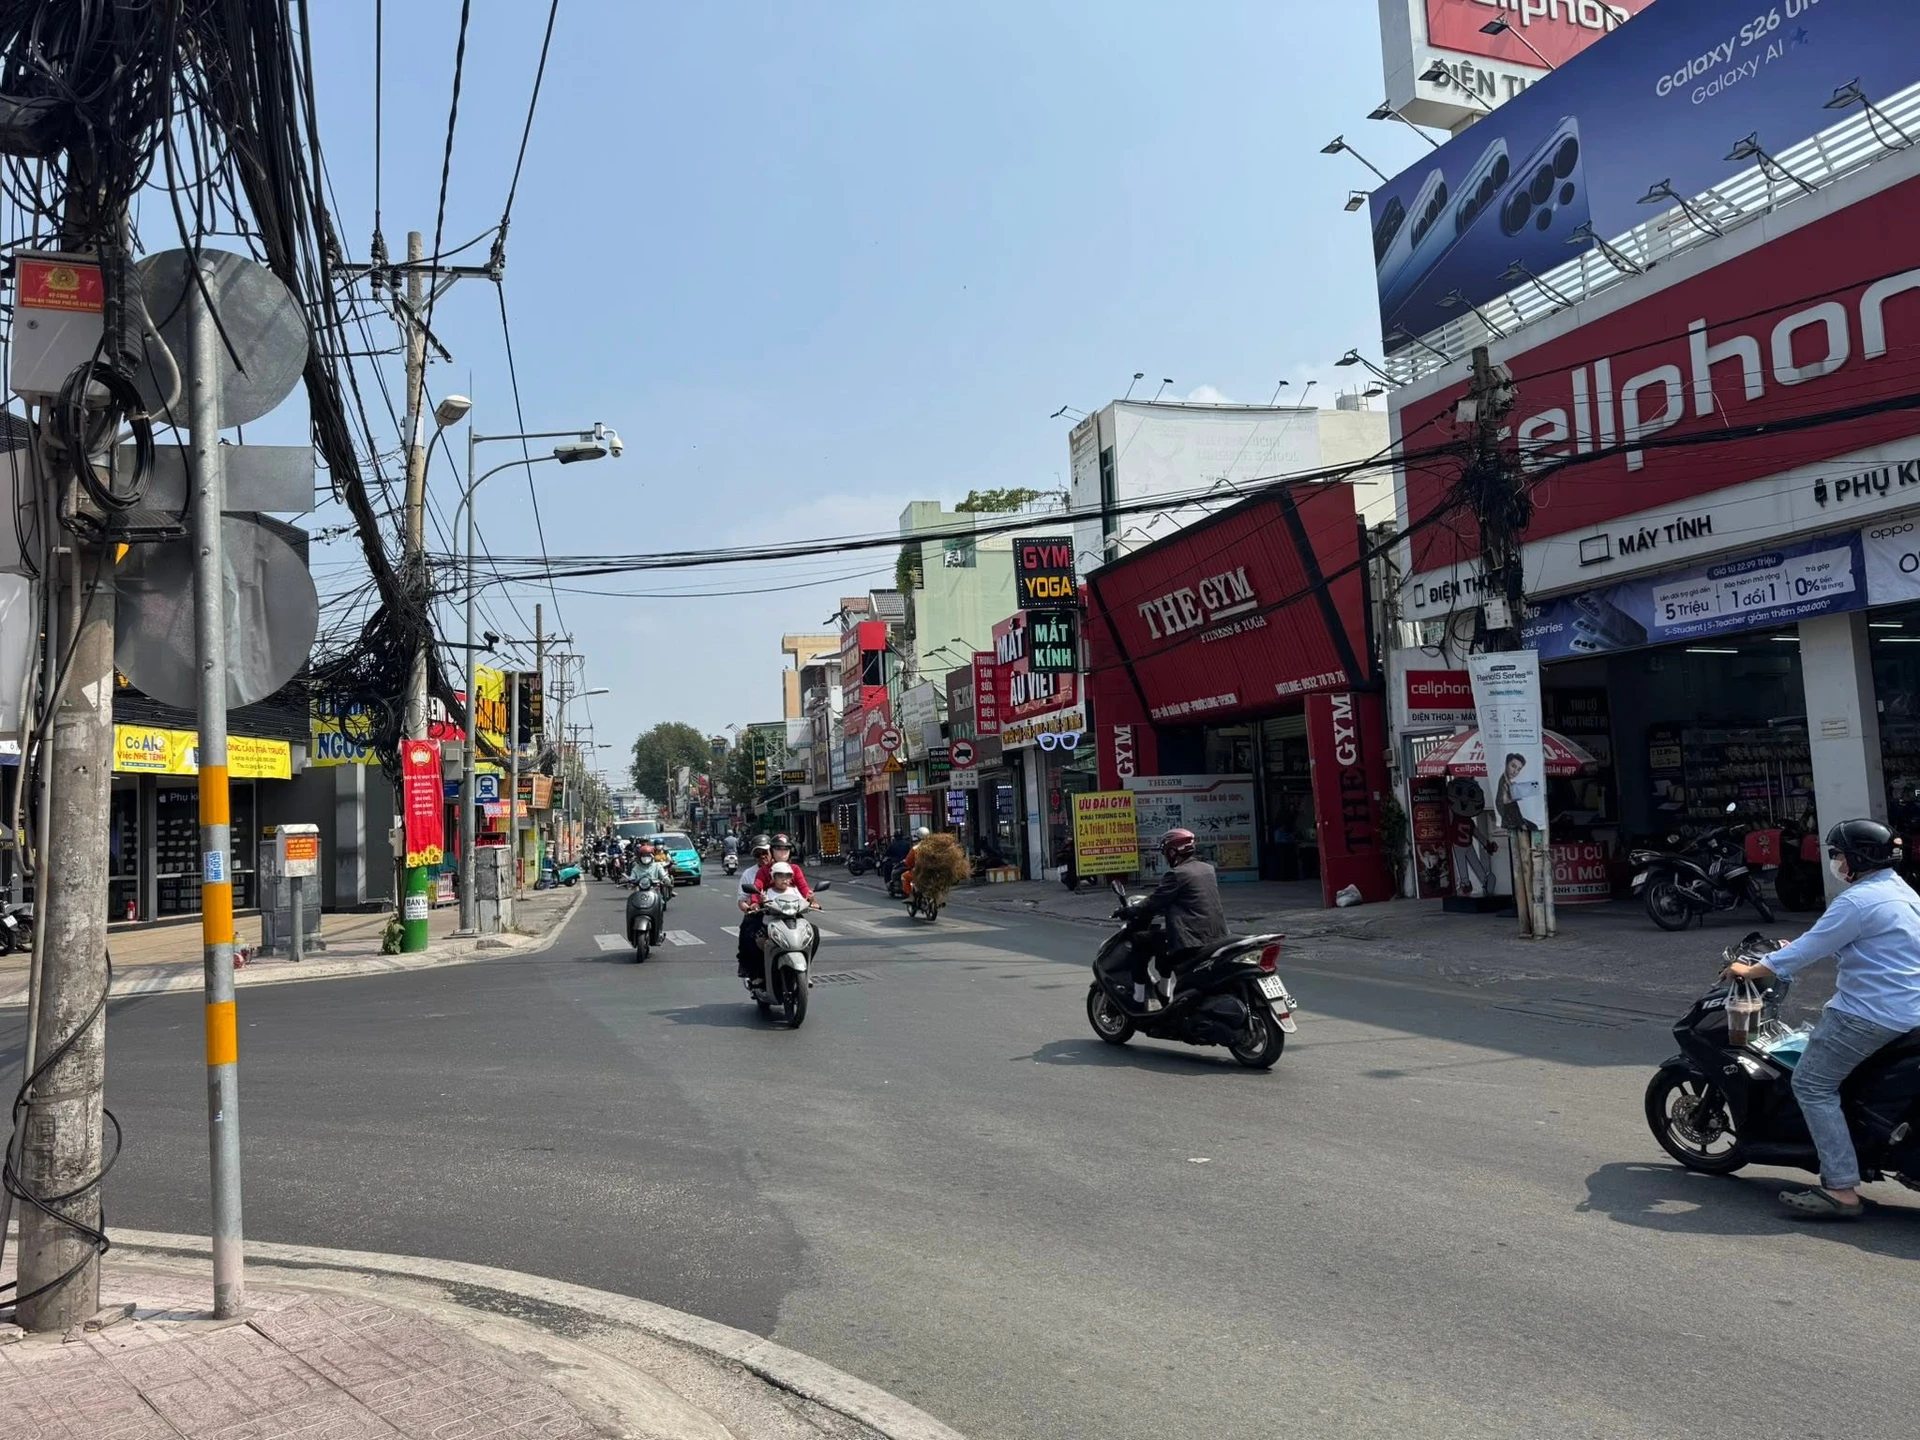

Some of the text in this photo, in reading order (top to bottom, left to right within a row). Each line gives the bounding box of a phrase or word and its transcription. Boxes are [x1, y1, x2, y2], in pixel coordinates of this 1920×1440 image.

[1656, 7, 1780, 97] Galaxy S26
[1691, 39, 1783, 104] Galaxy AI
[1835, 467, 1890, 502] PHỤ
[1619, 514, 1713, 555] MÁY TÍNH
[1870, 522, 1914, 541] oppo
[1023, 545, 1070, 569] GYM
[1025, 576, 1073, 598] YOGA
[1429, 579, 1461, 604] ĐIỆN
[1731, 583, 1776, 608] 1 đổi 1
[1795, 577, 1820, 596] 0%
[1137, 566, 1255, 640] THE GYM
[1665, 599, 1710, 621] 5 Triệu
[1034, 616, 1069, 642] MẮT
[1242, 615, 1268, 631] YOGA
[1535, 622, 1563, 636] Series
[1034, 644, 1072, 666] KÍNH
[1010, 671, 1026, 707] ÂU
[1412, 711, 1430, 722] ĐIỆN
[1431, 712, 1454, 723] THOẠI
[1330, 693, 1358, 766] GYM
[125, 736, 140, 749] Có
[1113, 724, 1135, 779] GYM
[170, 792, 188, 804] Phụ
[1110, 796, 1131, 808] GYM
